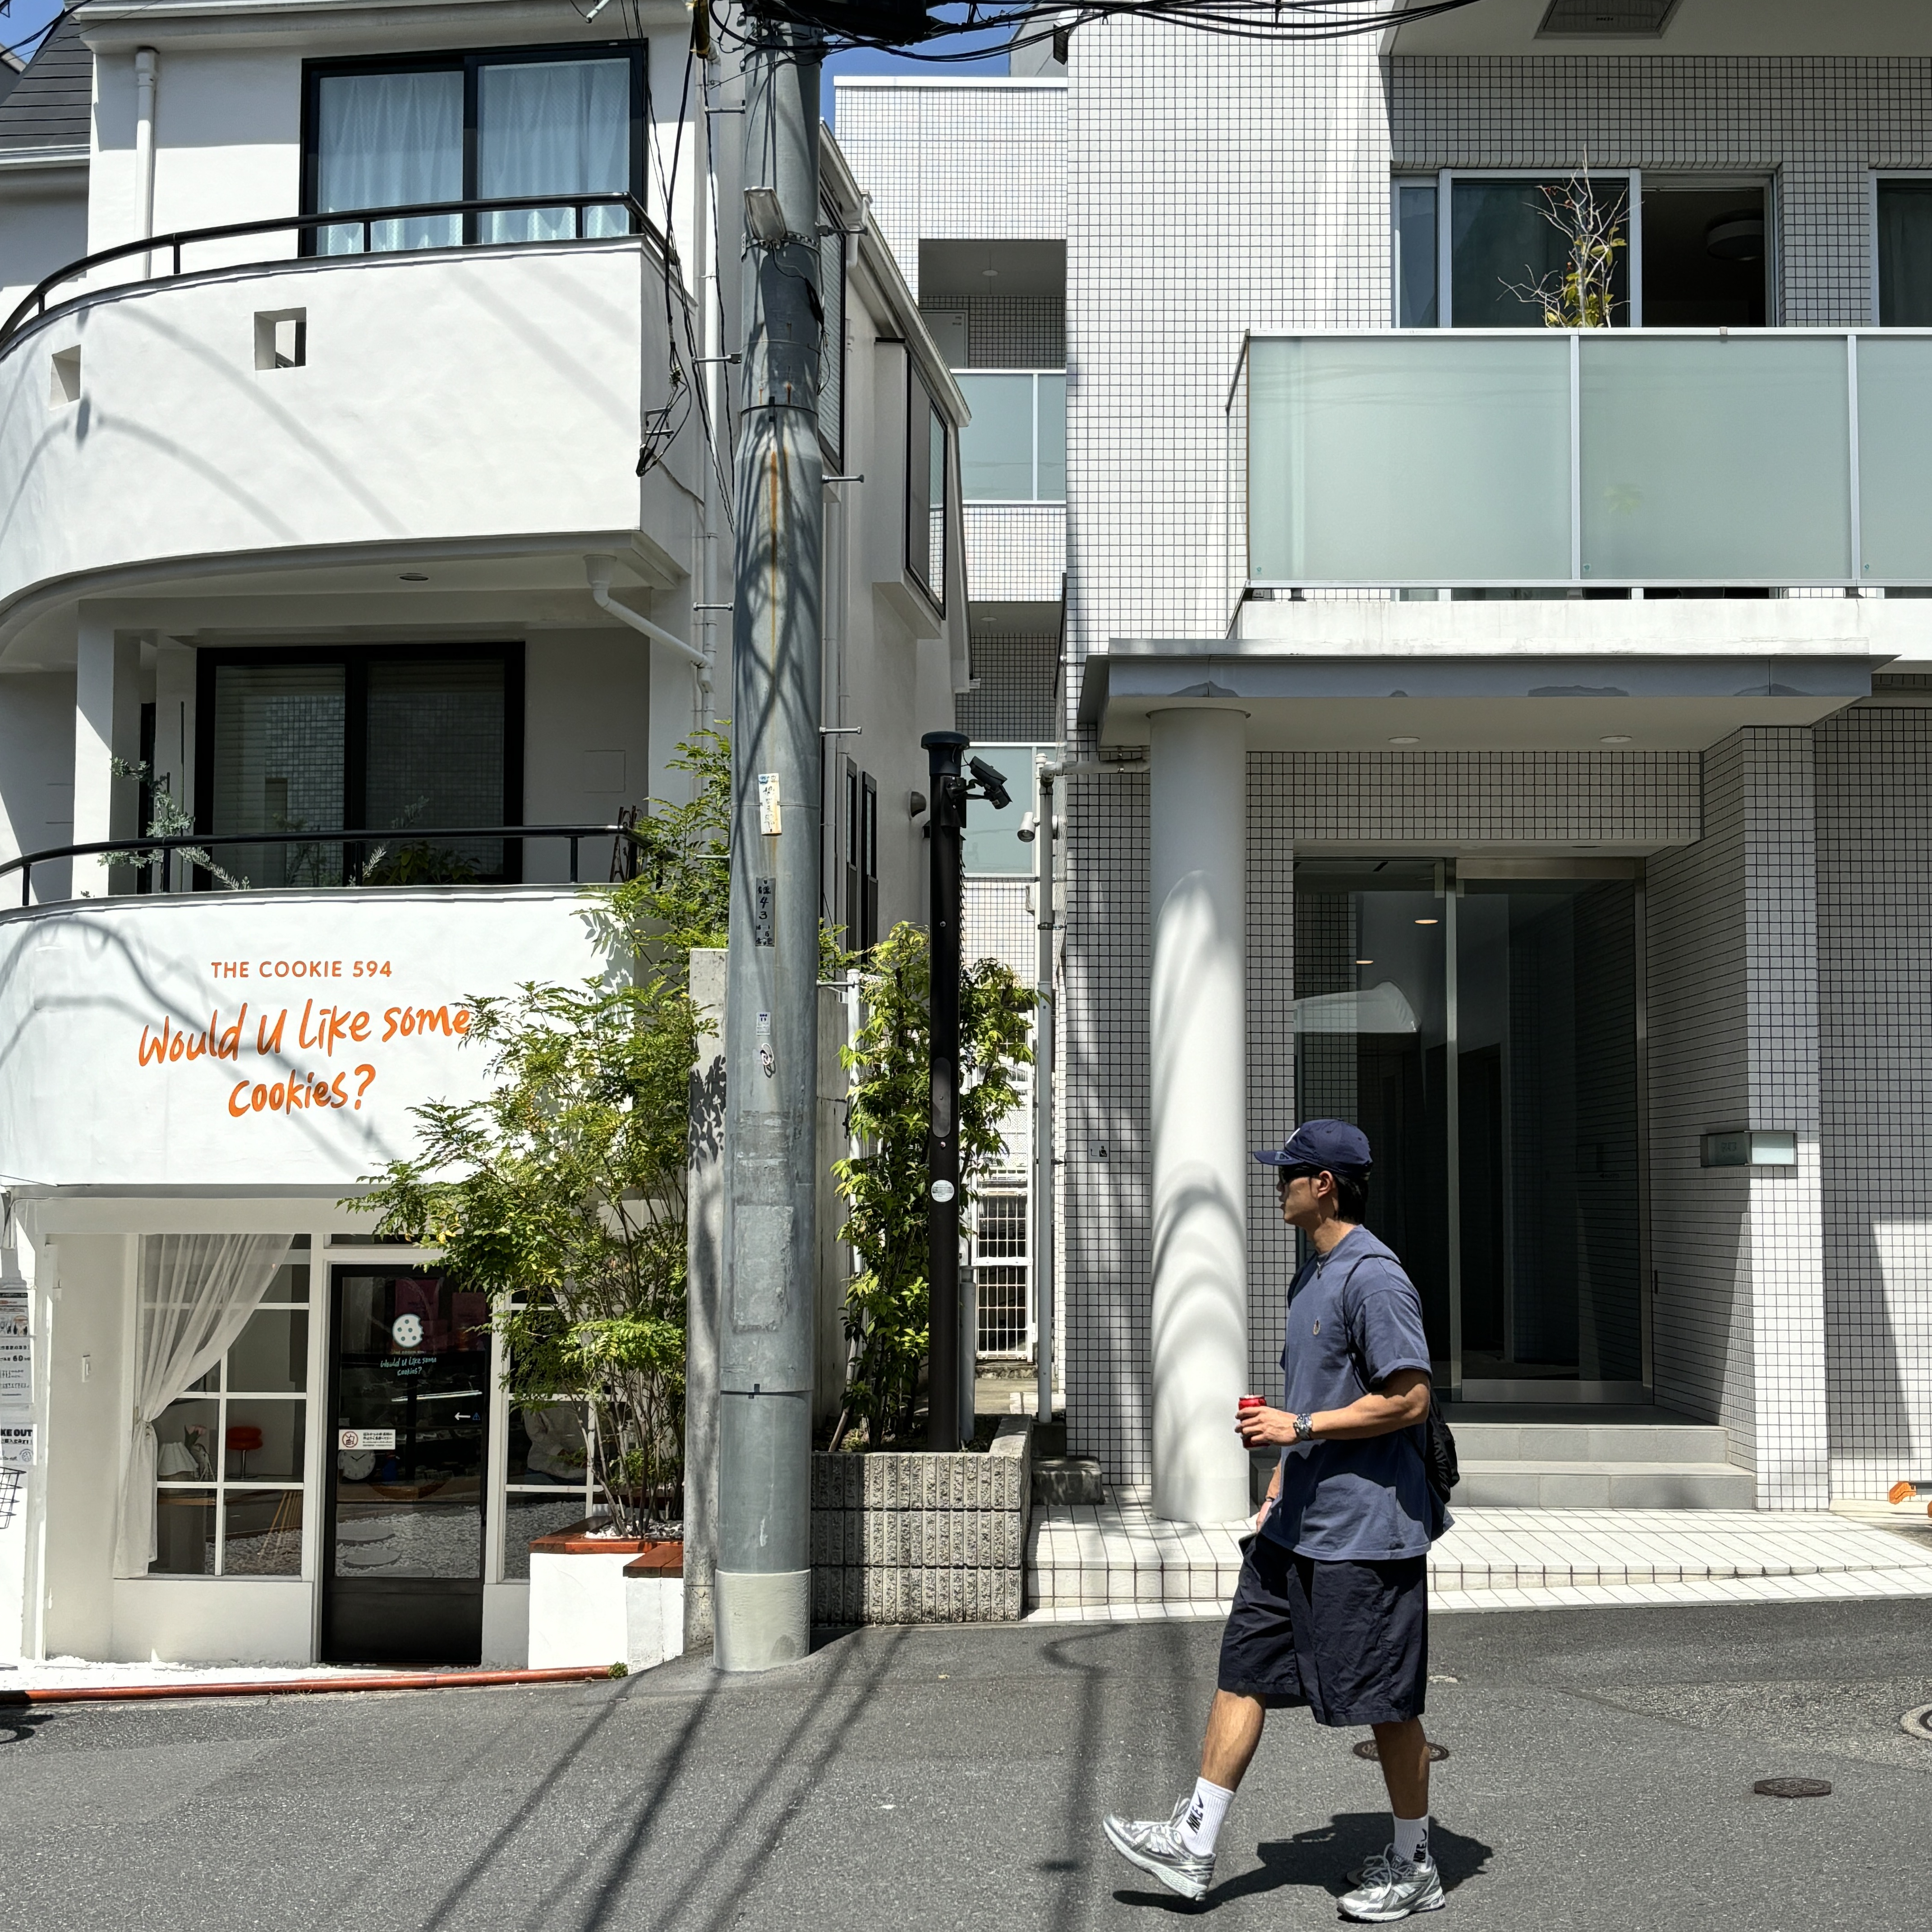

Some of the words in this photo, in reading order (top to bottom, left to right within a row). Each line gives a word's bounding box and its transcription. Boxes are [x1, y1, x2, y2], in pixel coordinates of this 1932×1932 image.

[211, 961, 248, 978] THE
[259, 961, 342, 978] COOKIE
[353, 961, 392, 978] 594
[138, 1003, 248, 1067] Would
[257, 1009, 287, 1055] U
[299, 998, 371, 1057] Like
[382, 1006, 471, 1042] some
[228, 1063, 376, 1118] cookies?
[0, 1429, 13, 1437] KE
[14, 1429, 33, 1437] OUT
[1186, 1805, 1204, 1836] NIKE
[1413, 1842, 1427, 1863] NIKE
